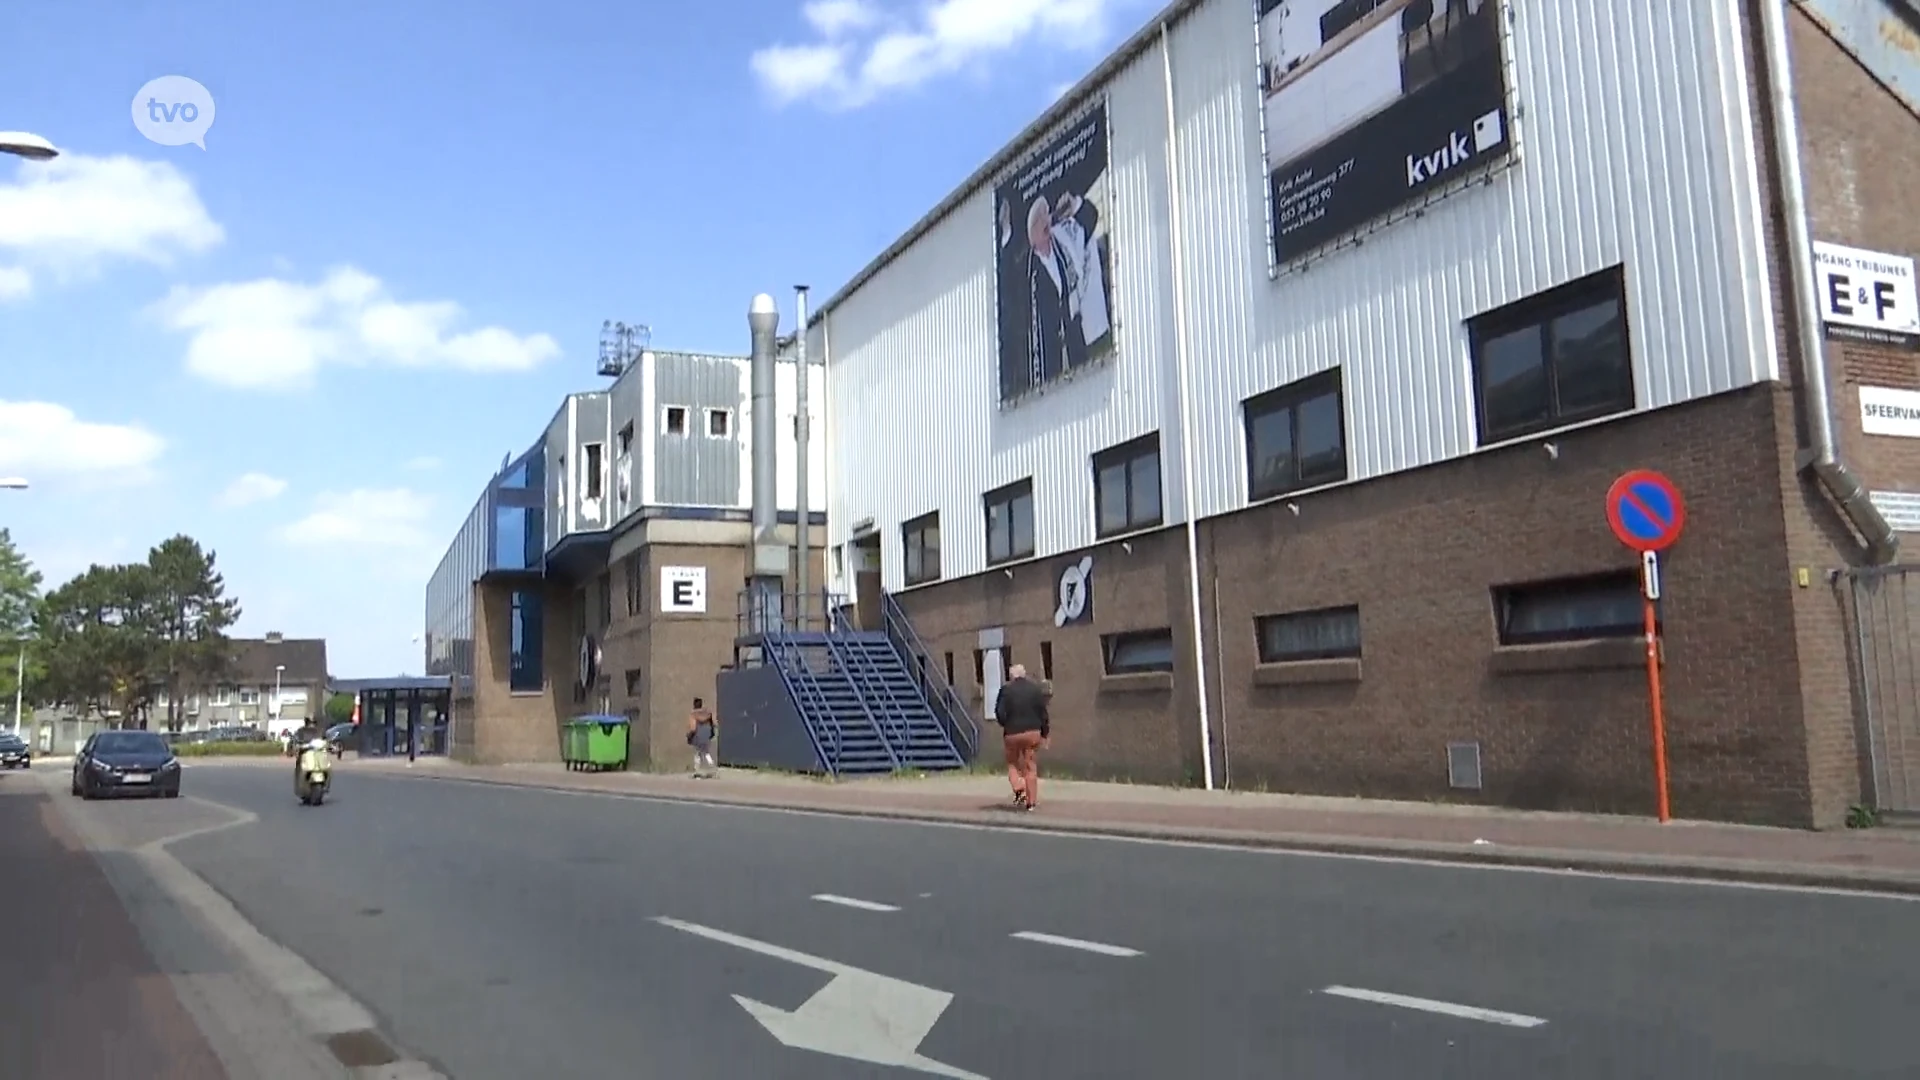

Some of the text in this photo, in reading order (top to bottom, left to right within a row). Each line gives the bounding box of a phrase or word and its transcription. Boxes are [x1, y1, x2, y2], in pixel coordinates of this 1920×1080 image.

[1407, 131, 1470, 187] kvik
[1815, 252, 1907, 277] NGANG TRIBUNES
[1827, 272, 1896, 320] E & F
[673, 580, 694, 606] E
